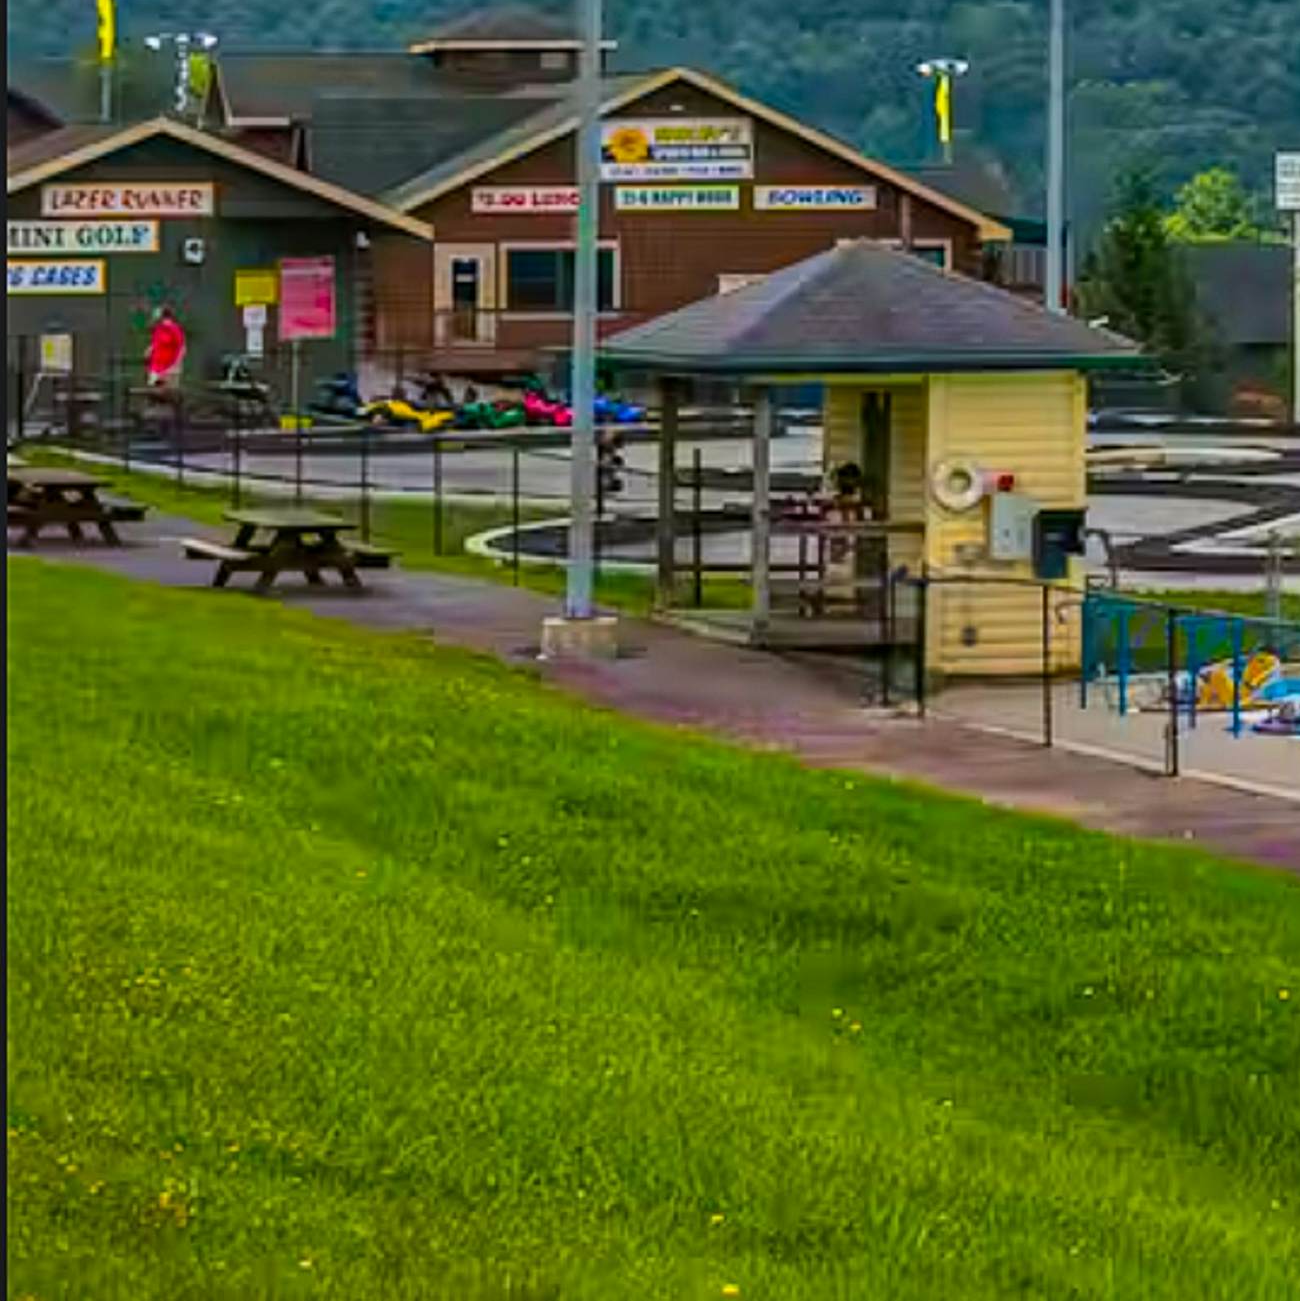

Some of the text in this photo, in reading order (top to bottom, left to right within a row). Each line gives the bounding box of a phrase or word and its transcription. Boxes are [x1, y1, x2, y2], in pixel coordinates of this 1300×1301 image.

[51, 189, 203, 210] LAZER RUNNER
[768, 189, 863, 205] BOWLING
[75, 224, 150, 247] GOLF
